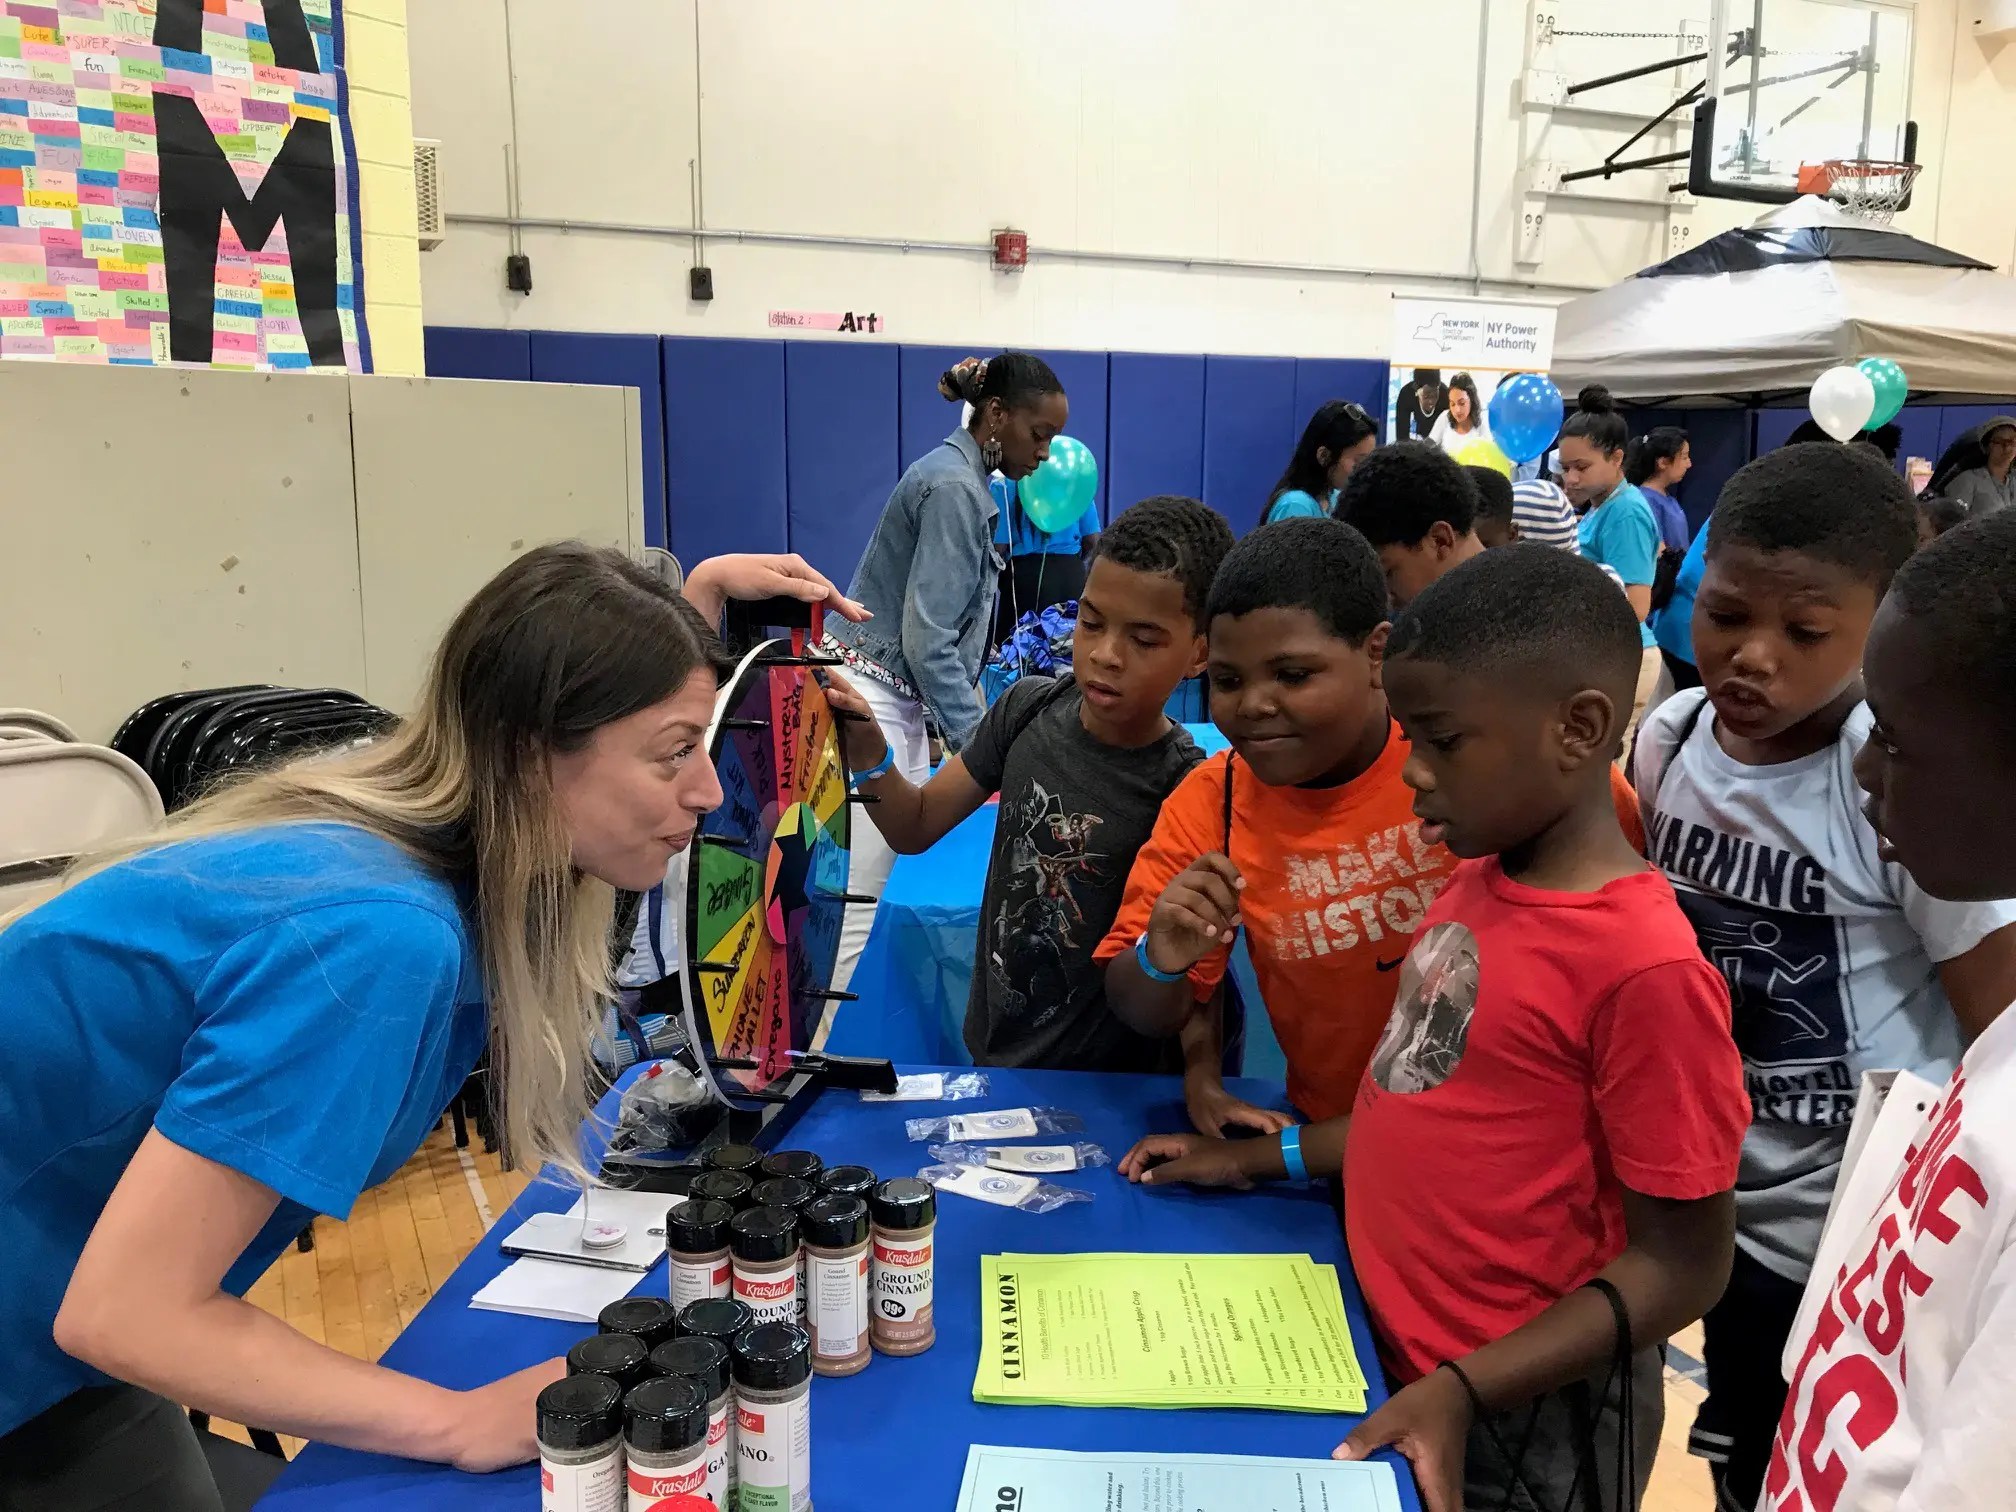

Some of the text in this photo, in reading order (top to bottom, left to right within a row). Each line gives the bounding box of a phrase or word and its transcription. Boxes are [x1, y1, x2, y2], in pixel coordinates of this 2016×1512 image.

[84, 57, 104, 73] fun
[242, 122, 276, 132] UPBEAT
[117, 228, 155, 243] LOVELY
[107, 274, 141, 288] Active
[217, 288, 256, 300] CAREFUL
[36, 303, 64, 316] Smart
[838, 311, 877, 333] Art
[1442, 319, 1479, 329] NEW YORK
[1487, 322, 1539, 335] NY Power
[1486, 337, 1537, 353] Authority
[886, 1250, 926, 1266] Krasdale
[881, 1268, 931, 1285] GROUND
[746, 1282, 789, 1299] Krasdale
[884, 1300, 904, 1315] 99¢
[1037, 1289, 1045, 1311] Cinnamon
[750, 1300, 794, 1318] ROUND
[999, 1274, 1021, 1379] CINNAMON
[1038, 1318, 1047, 1336] Benefits
[1132, 1291, 1150, 1352] Cinnamon Apple Crisp
[1155, 1311, 1163, 1331] Cinnamon
[1223, 1298, 1243, 1342] Spiced Oranges
[1040, 1337, 1048, 1353] Health
[1321, 1337, 1335, 1362] ingredients
[1291, 1350, 1305, 1372] Powdered
[1308, 1348, 1321, 1370] Cinnamon
[1168, 1370, 1176, 1382] Apple
[1332, 1363, 1343, 1383] Combine
[1346, 1369, 1356, 1383] Cover
[651, 1472, 703, 1498] Krasdale
[1116, 1483, 1124, 1509] drinking.
